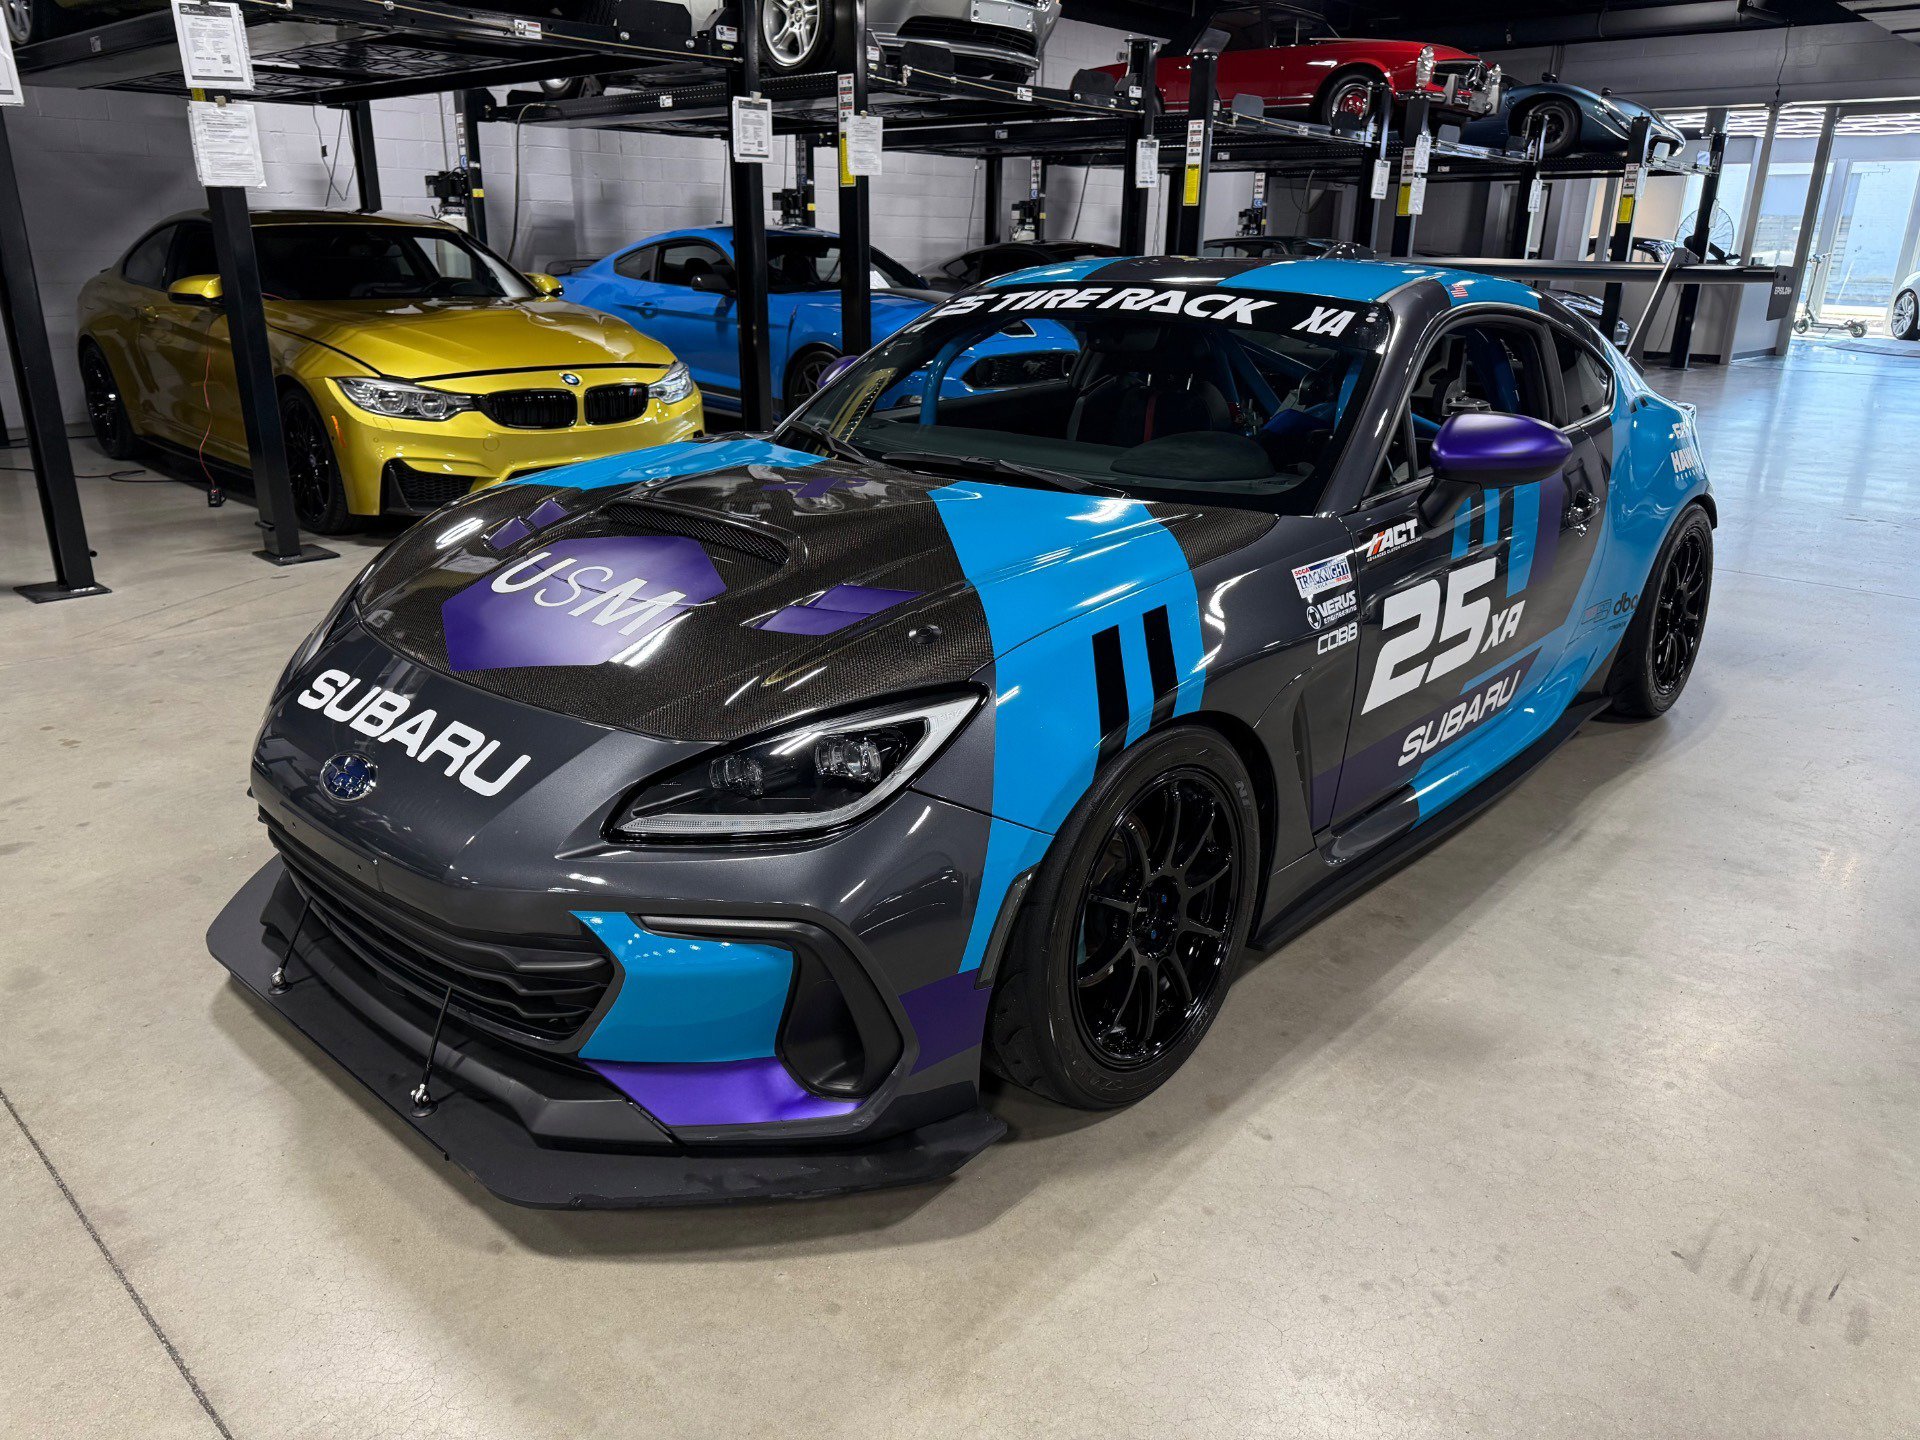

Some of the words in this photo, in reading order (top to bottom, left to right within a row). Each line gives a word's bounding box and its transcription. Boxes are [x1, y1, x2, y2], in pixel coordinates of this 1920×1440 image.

[988, 287, 1104, 313] TIRE
[1094, 288, 1277, 325] RACK
[1292, 306, 1356, 338] XA
[490, 552, 688, 638] USM
[1294, 567, 1310, 577] SCCA
[1317, 589, 1357, 618] VERUS
[1317, 621, 1358, 655] COBB
[1361, 557, 1498, 716] 25
[1480, 599, 1526, 654] XA
[297, 668, 532, 797] SUBARU
[1397, 670, 1521, 767] SUBARU
